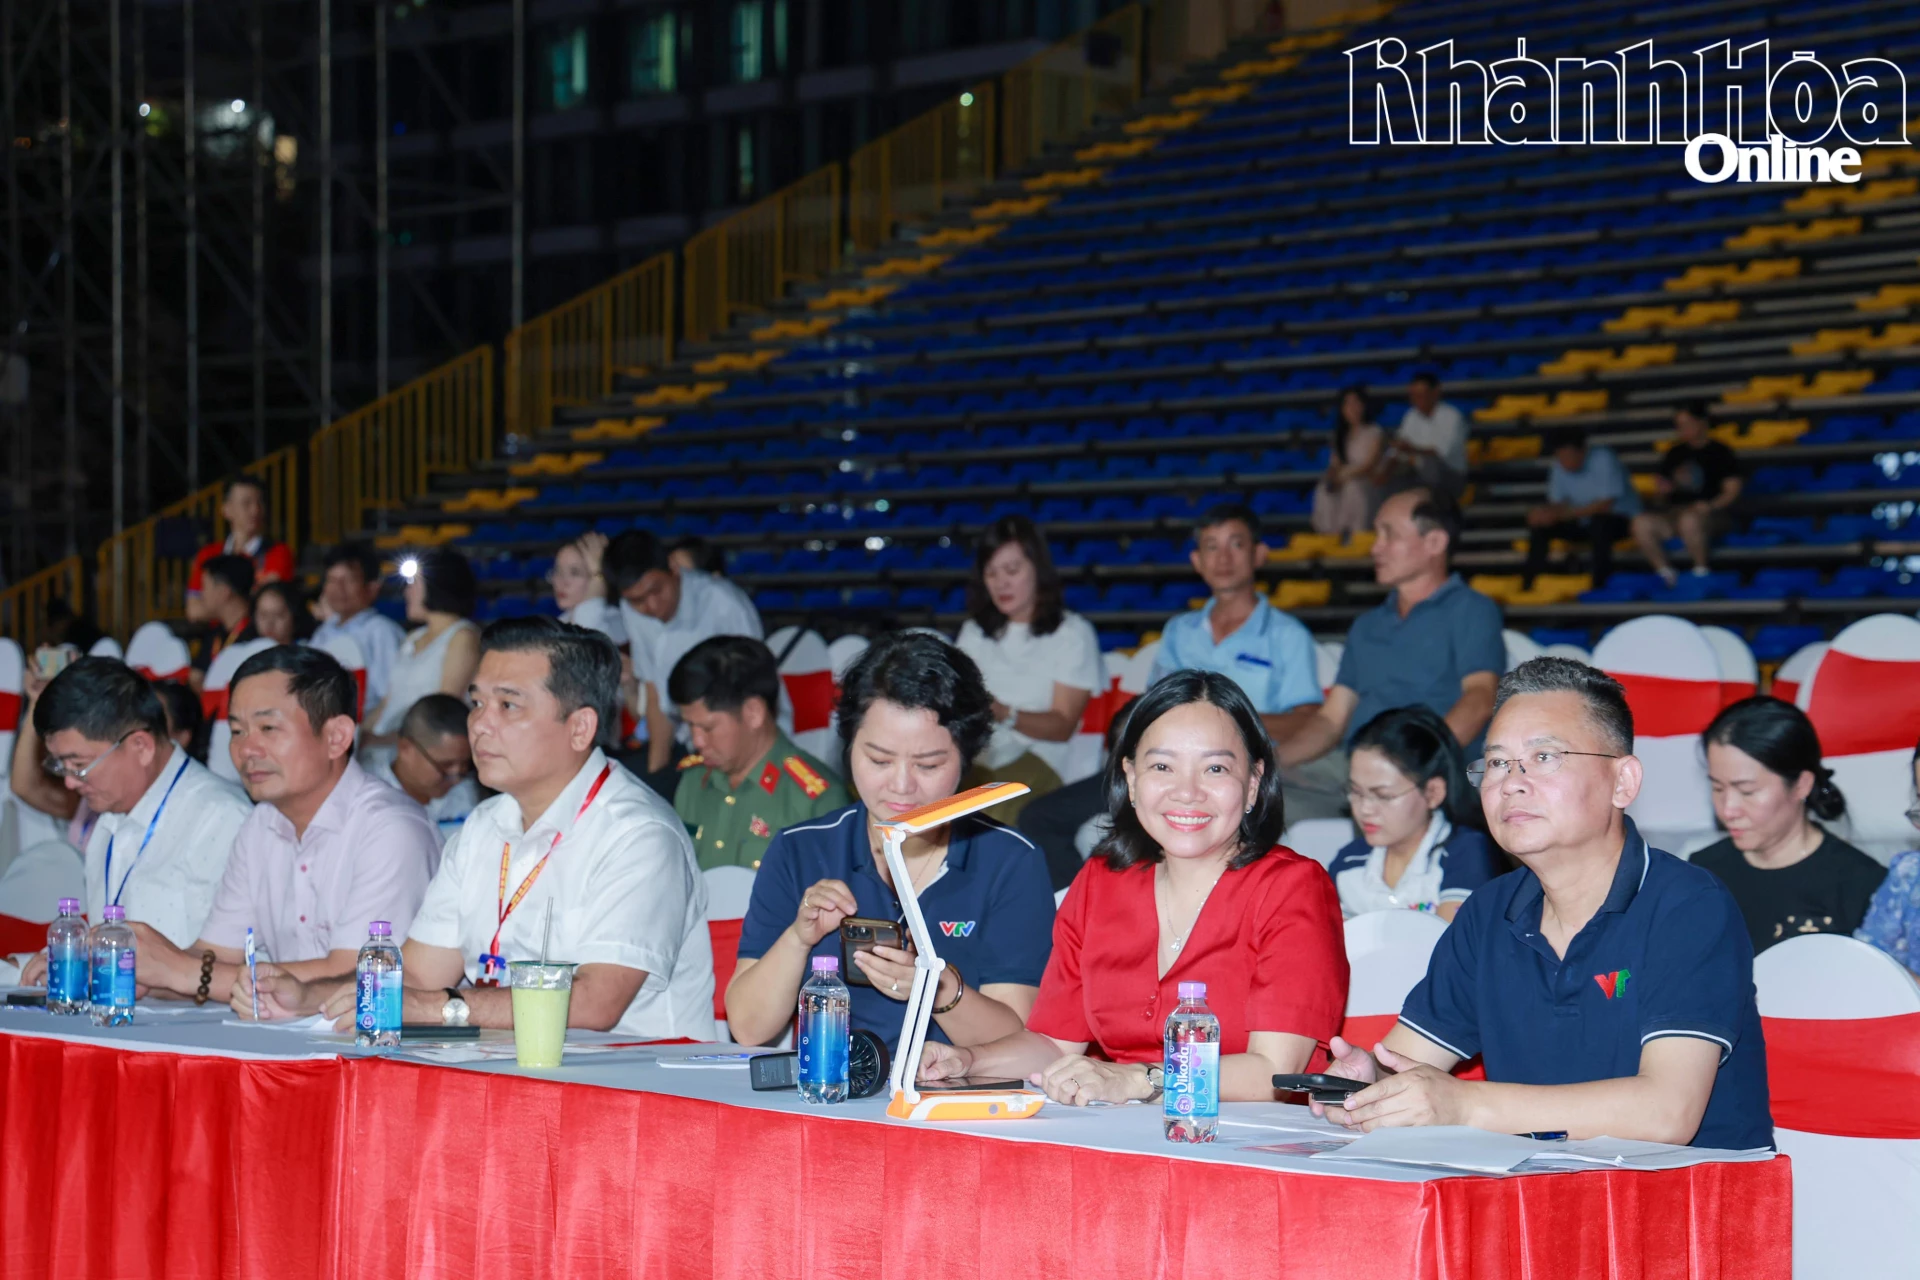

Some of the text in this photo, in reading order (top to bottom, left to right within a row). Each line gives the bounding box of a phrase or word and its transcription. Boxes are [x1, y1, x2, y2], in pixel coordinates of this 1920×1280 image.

[939, 921, 976, 938] VTV
[359, 973, 372, 1012] Vikoda
[1173, 1046, 1190, 1093] Vikoda
